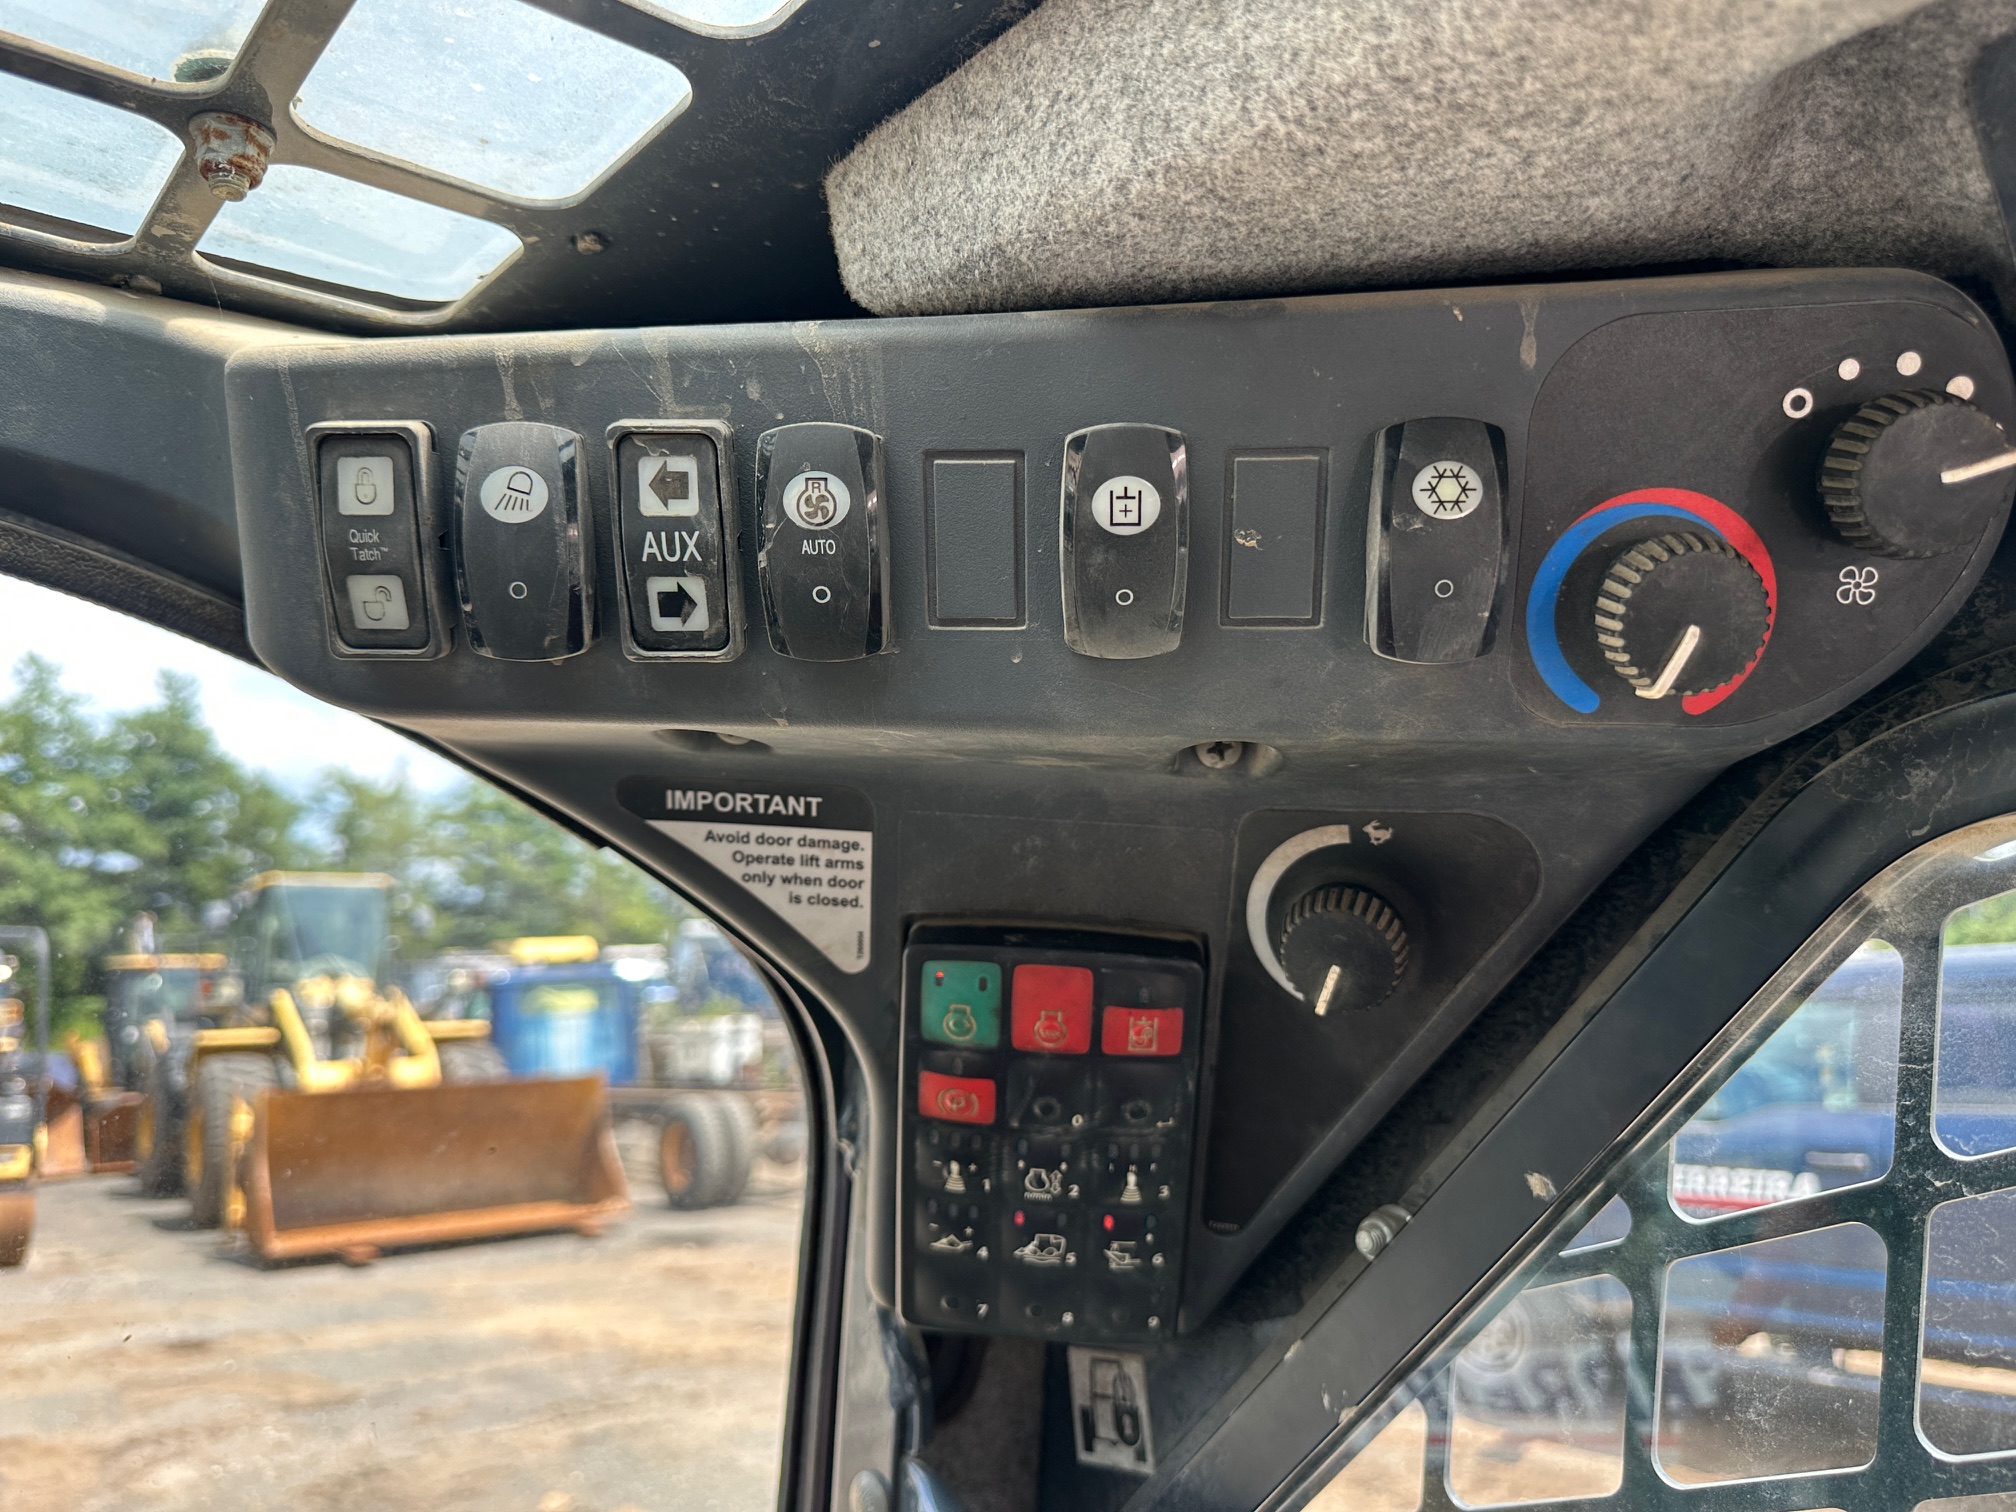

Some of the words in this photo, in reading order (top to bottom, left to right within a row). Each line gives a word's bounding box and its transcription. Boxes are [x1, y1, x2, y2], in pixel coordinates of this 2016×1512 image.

[349, 528, 379, 545] Quick
[641, 530, 703, 563] AUX
[801, 538, 837, 556] AUTO
[665, 789, 823, 818] IMPORTANT
[704, 829, 750, 845] Avoid
[755, 831, 793, 847] door
[798, 834, 865, 852] damage.
[732, 850, 795, 867] Operate
[800, 853, 820, 868] lift
[824, 857, 864, 870] arms
[741, 870, 776, 887] only
[781, 873, 823, 887] when
[828, 875, 865, 890] door
[789, 891, 802, 905] is
[807, 892, 863, 909] closed.
[1067, 1184, 1081, 1199] 2
[1158, 1184, 1170, 1199] 3
[976, 1246, 989, 1260] 4
[1065, 1252, 1077, 1266] 5
[1152, 1252, 1164, 1267] 6
